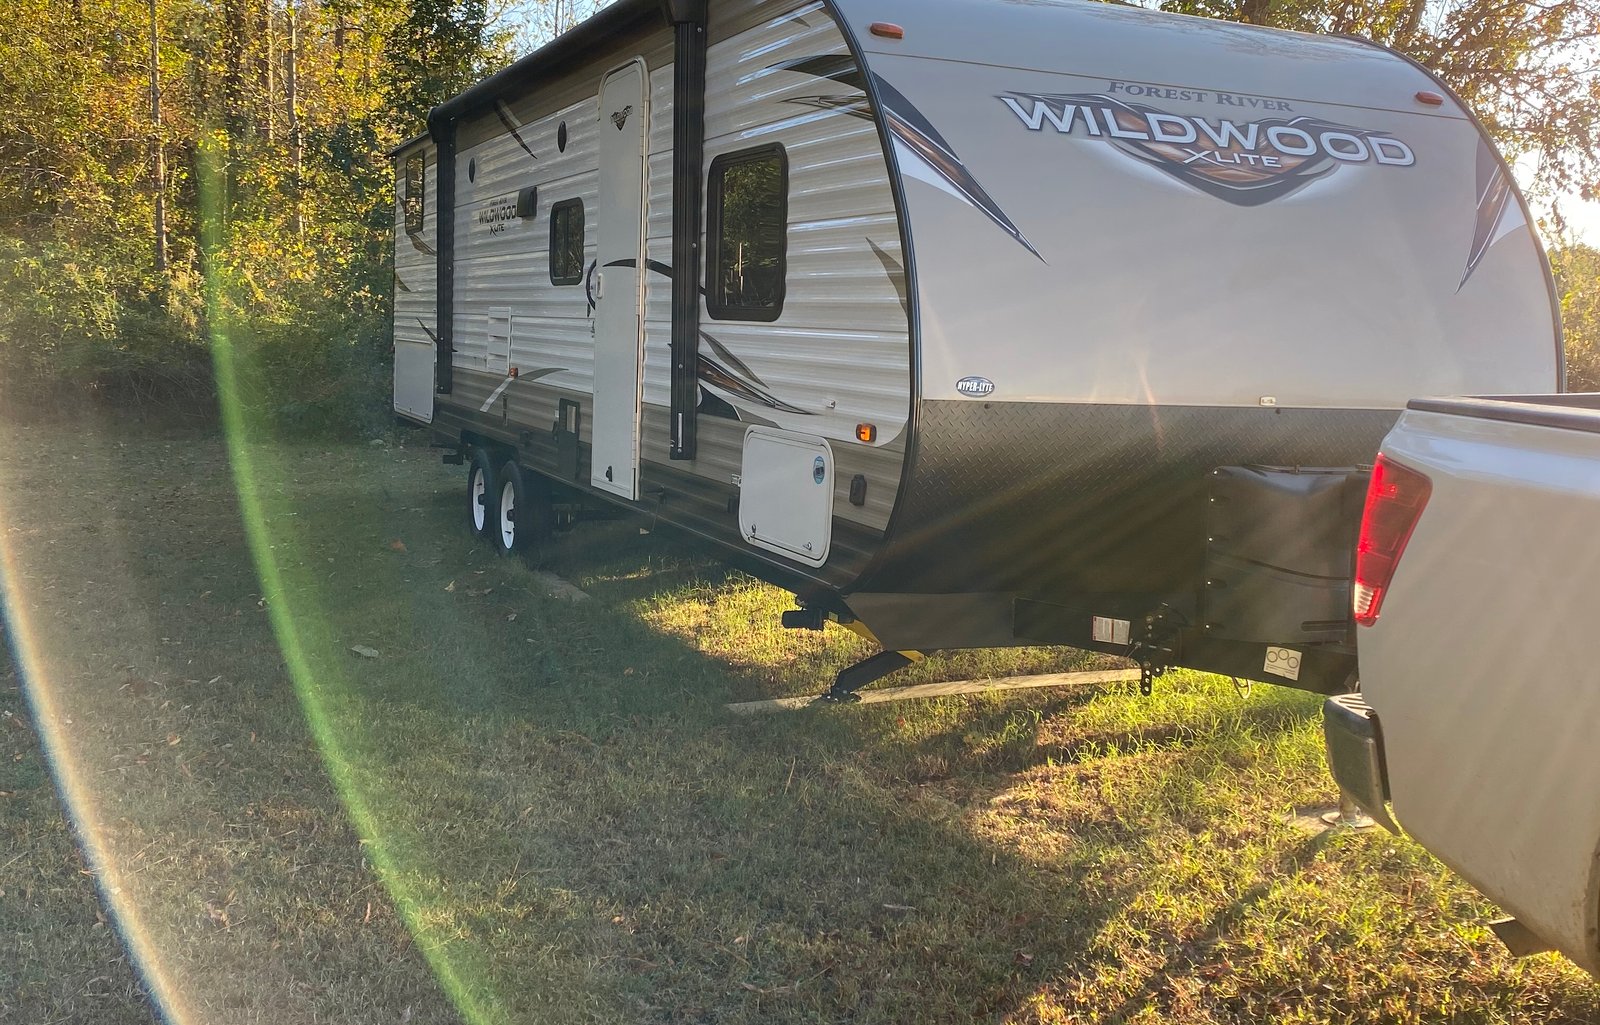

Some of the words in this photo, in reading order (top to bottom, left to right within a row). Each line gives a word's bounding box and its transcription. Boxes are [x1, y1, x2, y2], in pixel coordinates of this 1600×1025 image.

[1108, 81, 1209, 103] FOREST
[1215, 92, 1295, 112] RIVER
[1000, 95, 1417, 168] WILDWOOD
[479, 205, 517, 224] WILDWOOD
[957, 381, 994, 392] HYPER-LITE
